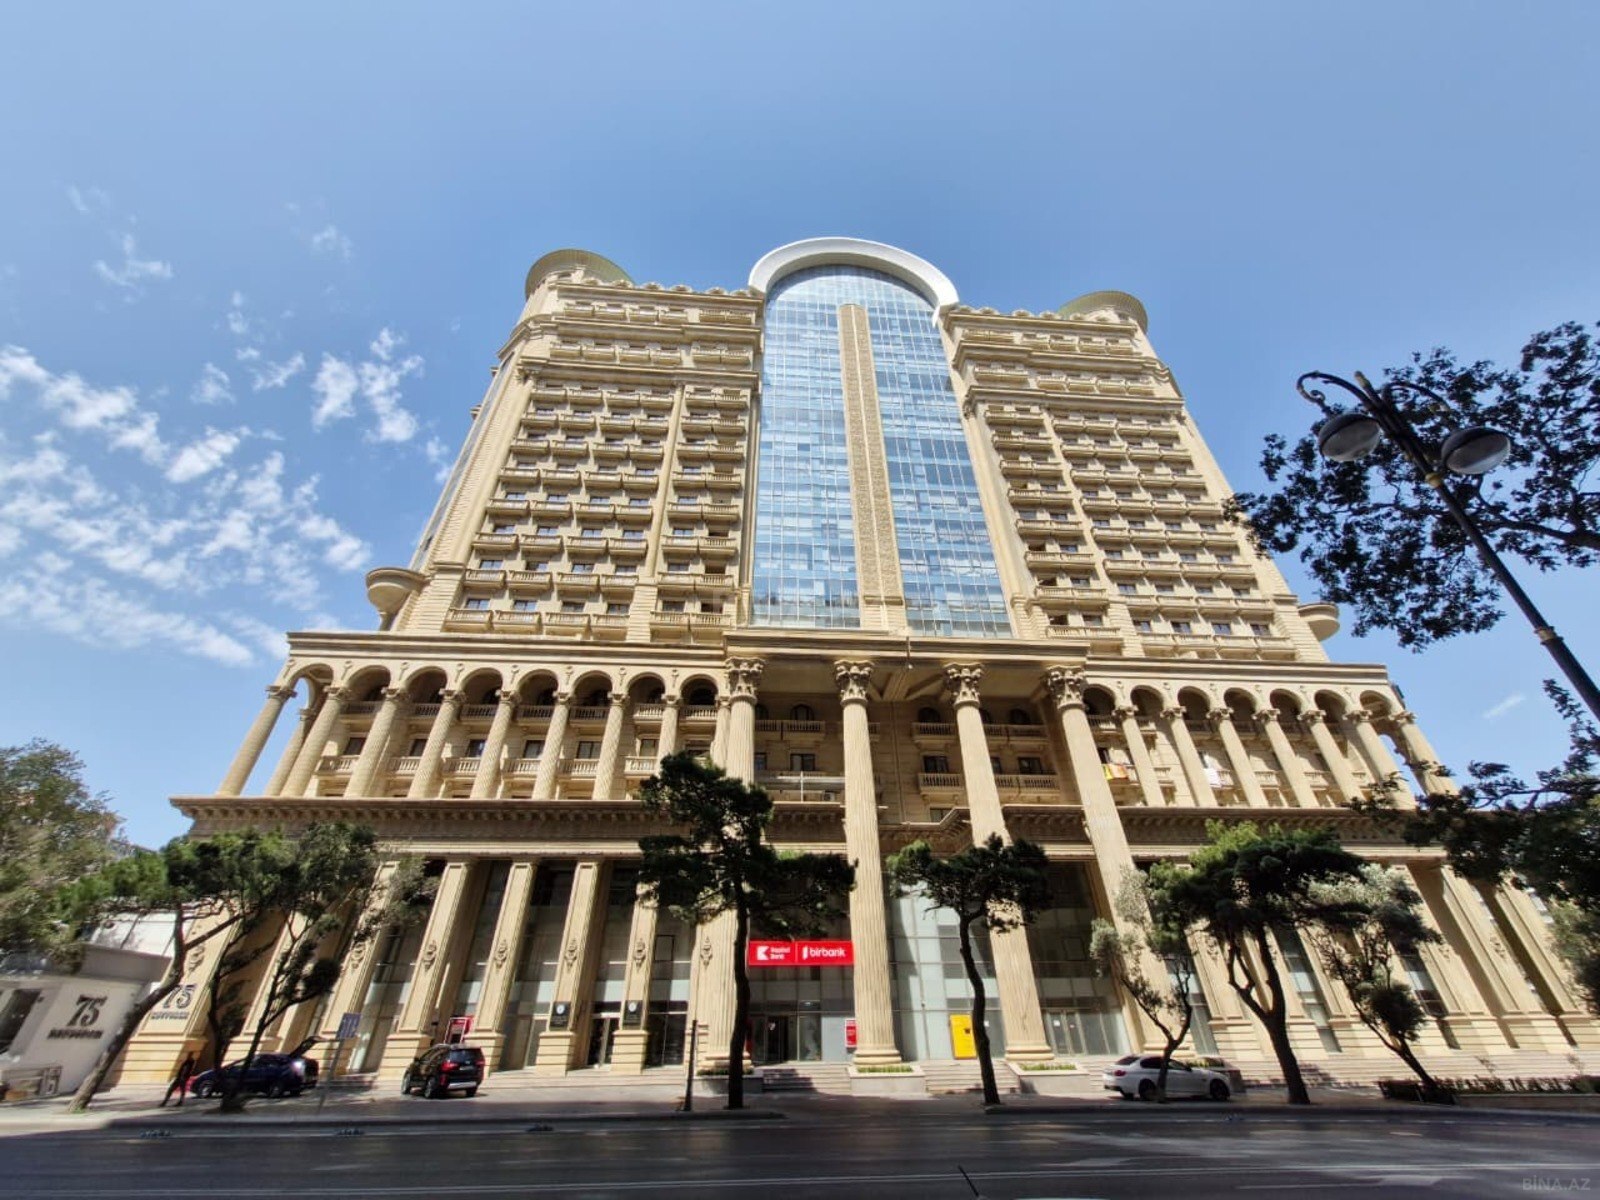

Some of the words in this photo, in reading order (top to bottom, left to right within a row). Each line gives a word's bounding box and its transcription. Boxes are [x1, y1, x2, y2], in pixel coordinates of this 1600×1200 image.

[809, 946, 846, 958] birbank
[163, 983, 197, 1009] 75
[66, 994, 108, 1027] 75
